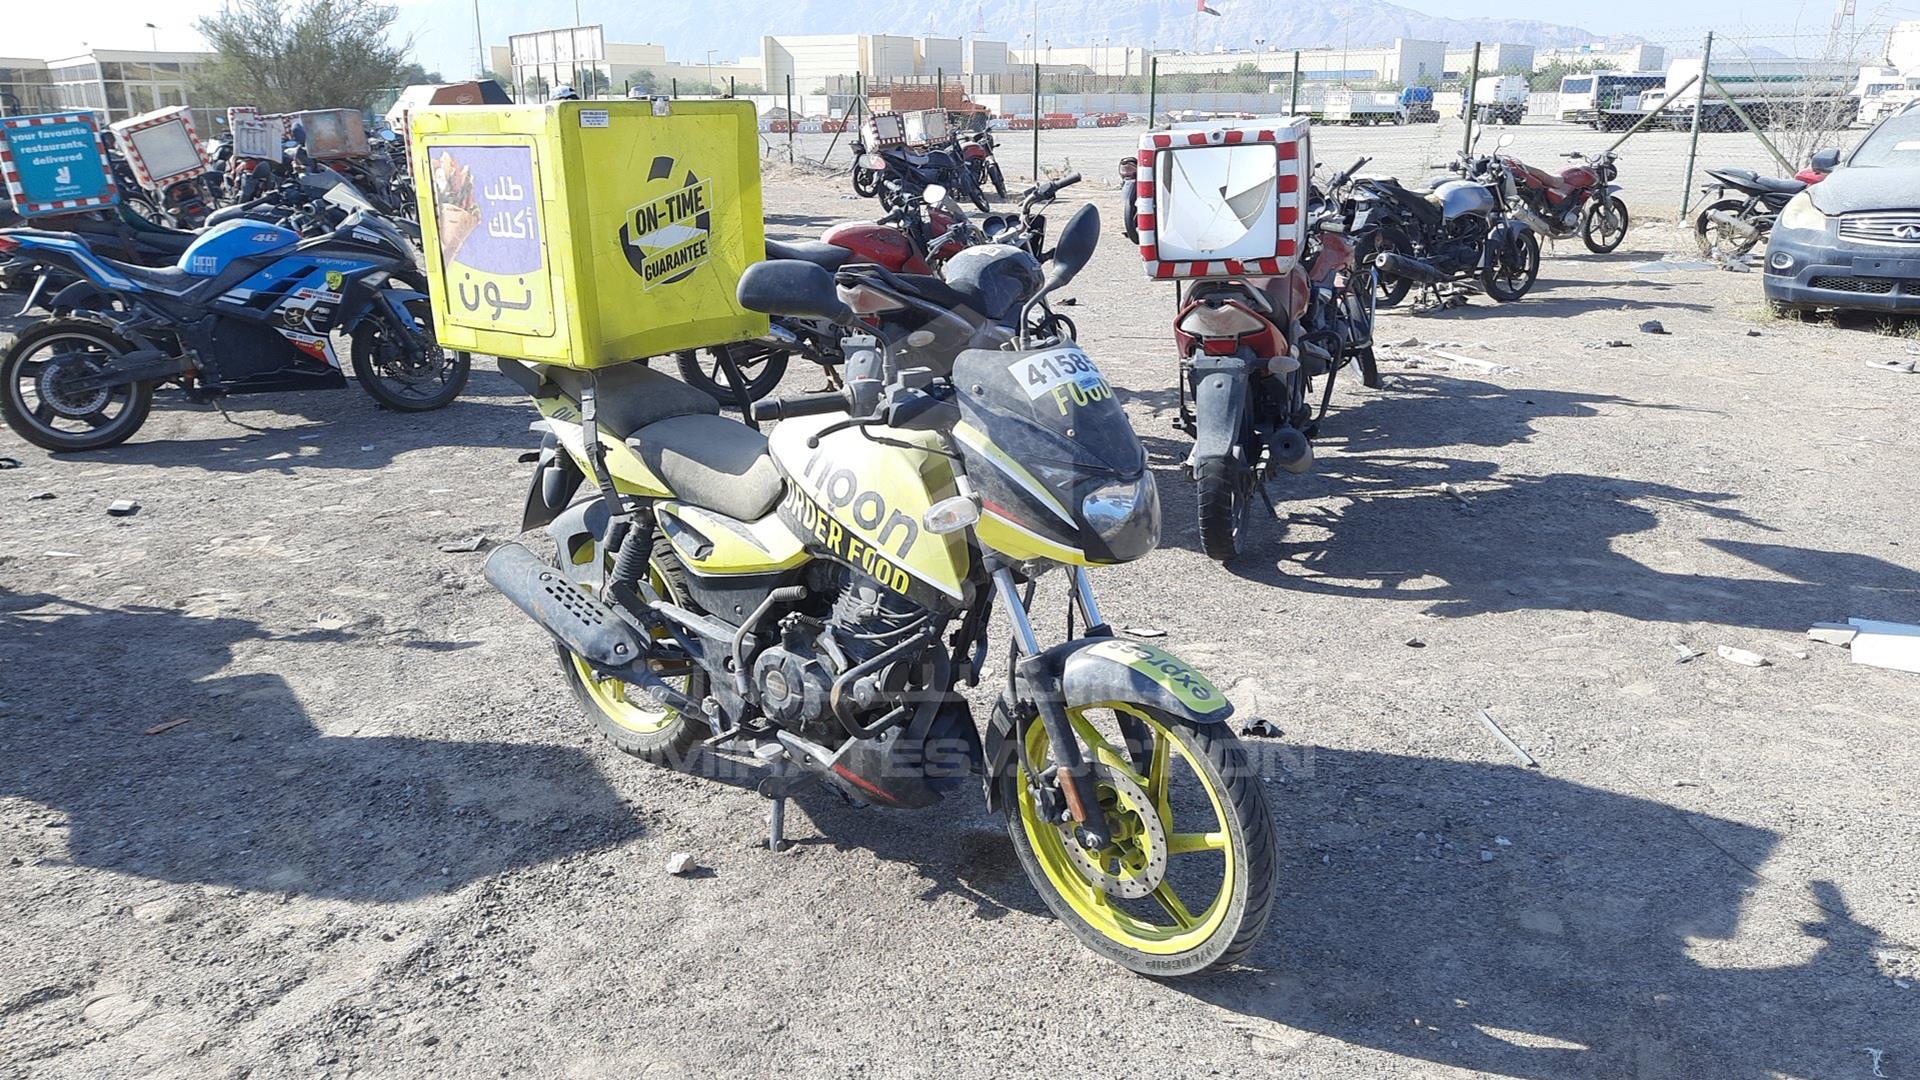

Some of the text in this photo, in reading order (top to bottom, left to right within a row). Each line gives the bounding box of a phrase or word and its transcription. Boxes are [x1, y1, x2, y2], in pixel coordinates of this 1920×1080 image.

[11, 127, 87, 143] your favourite
[33, 152, 83, 165] delivered
[484, 176, 524, 206] طلب
[635, 186, 704, 236] ON-TIME
[488, 206, 535, 239] أكلك
[644, 239, 708, 282] GUARANTEE
[459, 272, 532, 321] نون
[784, 476, 910, 595] ORDER FOOD
[1107, 640, 1211, 701] express
